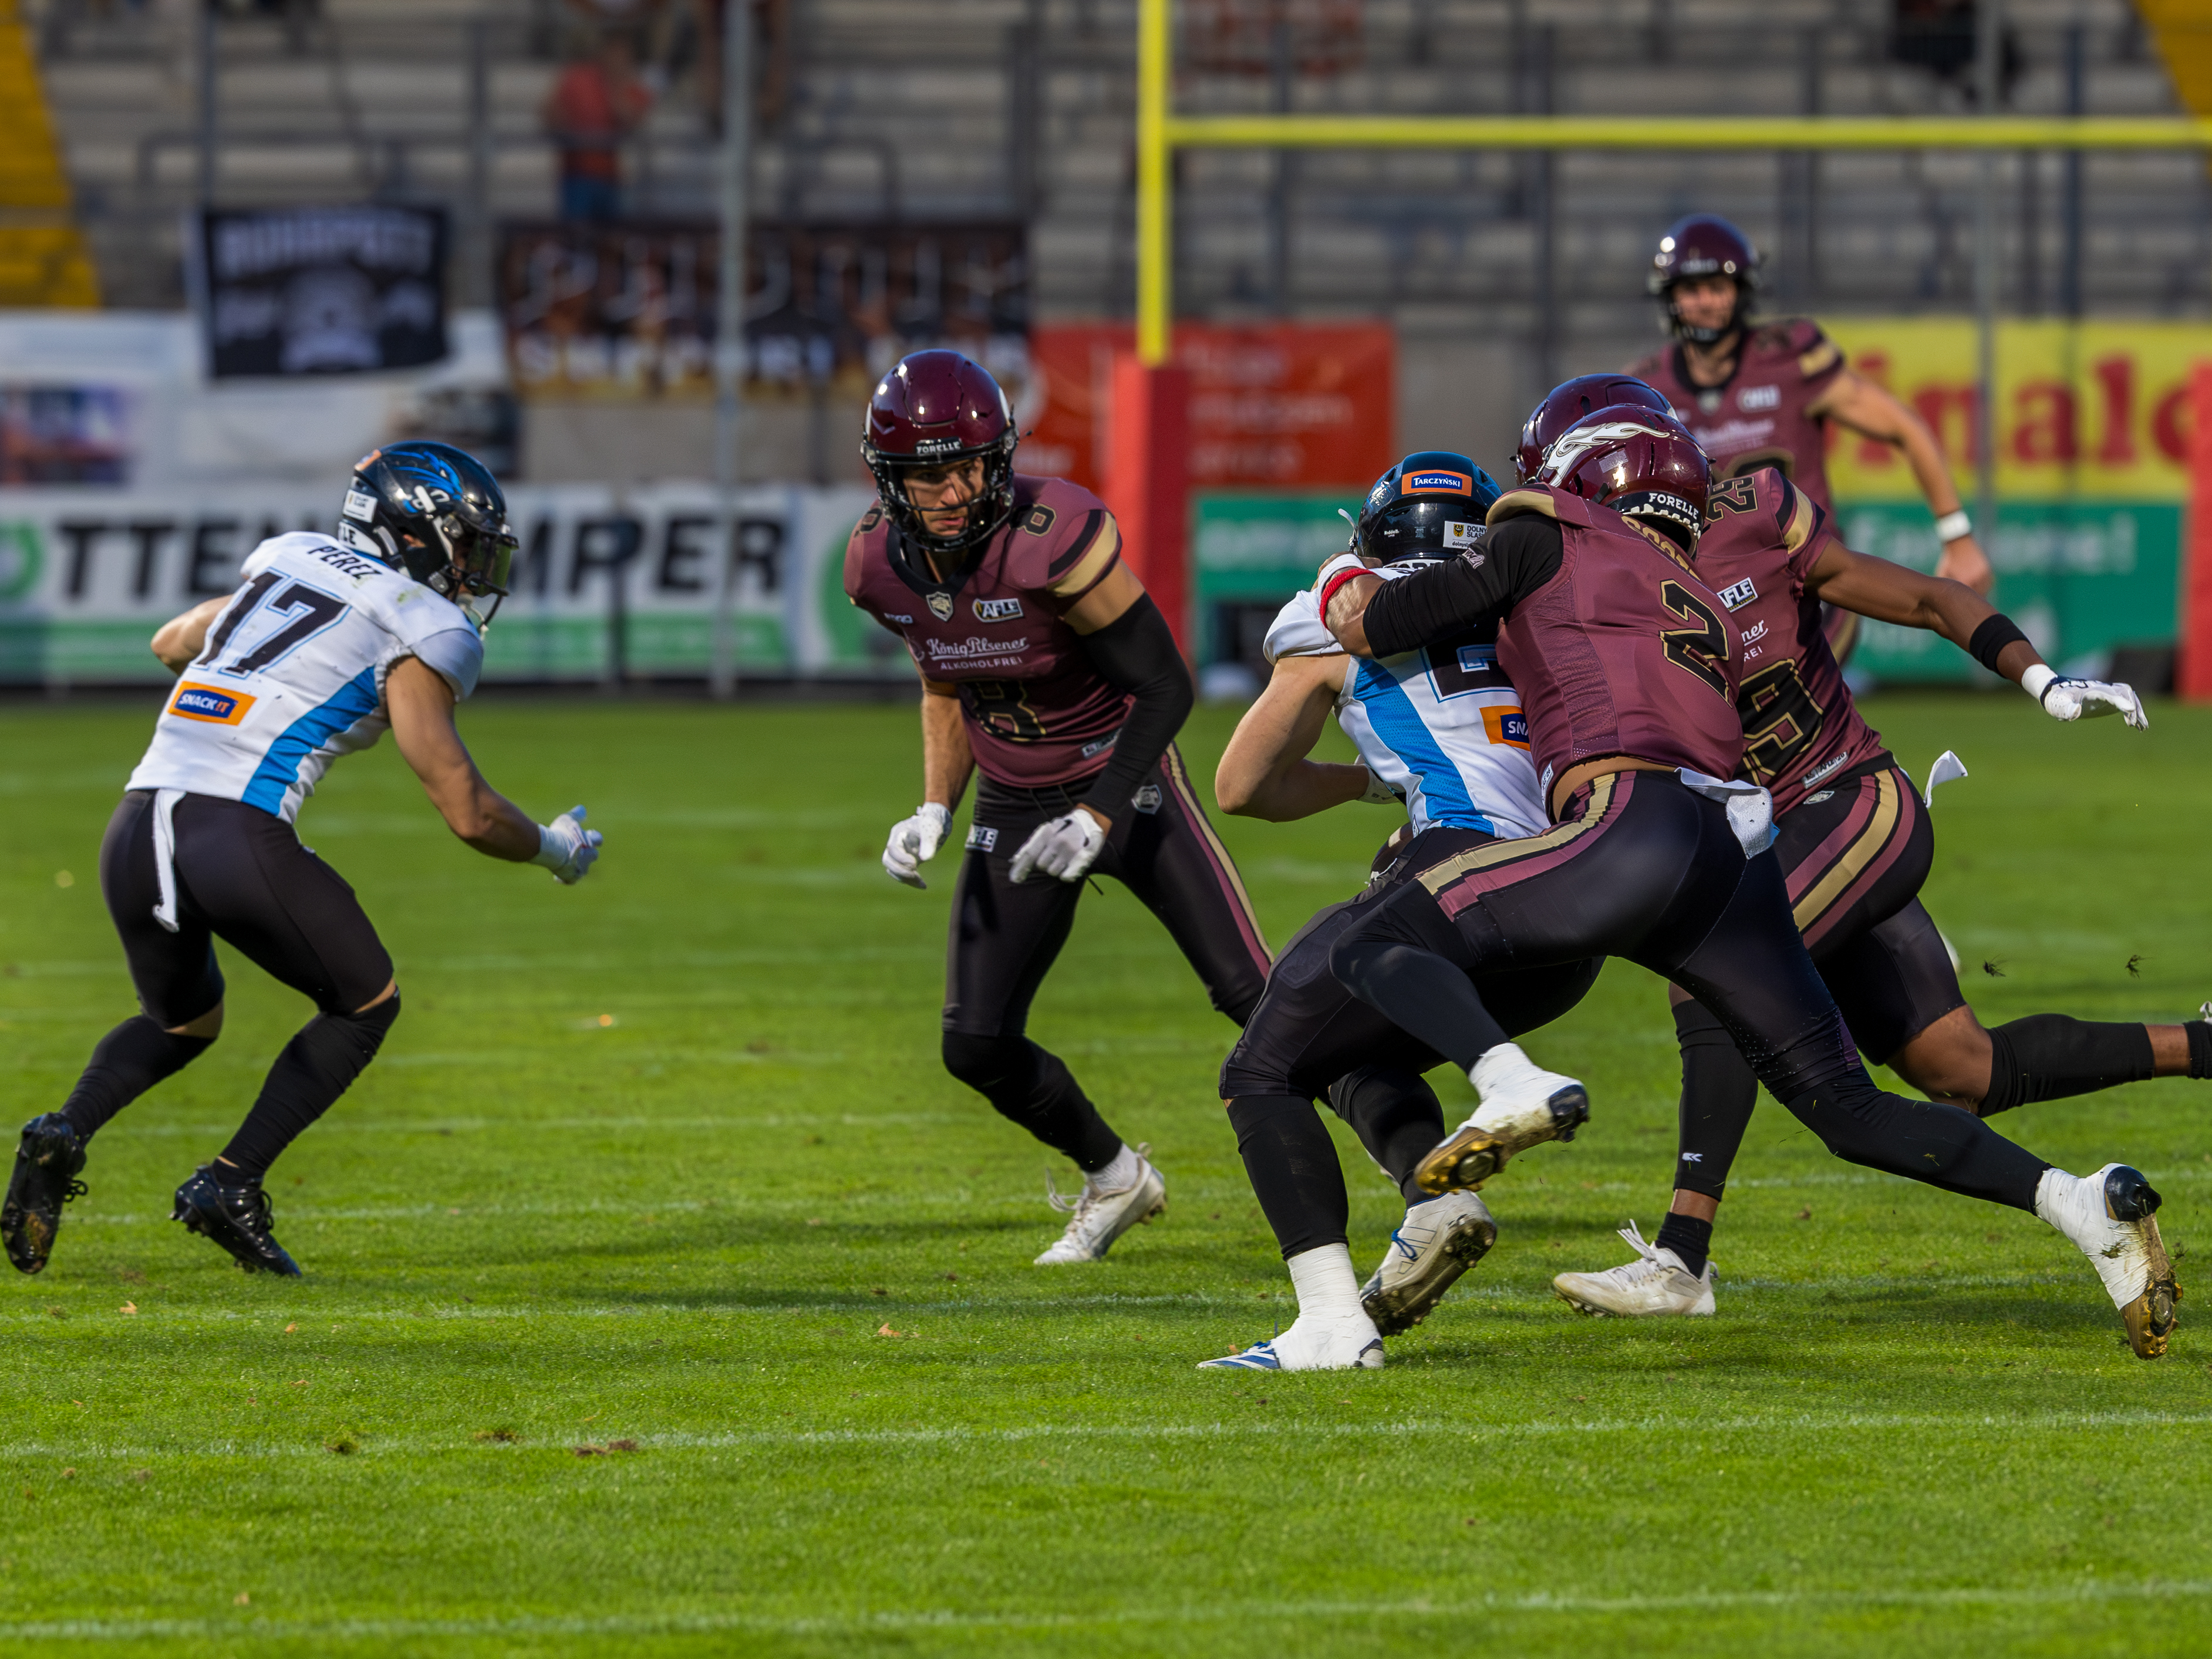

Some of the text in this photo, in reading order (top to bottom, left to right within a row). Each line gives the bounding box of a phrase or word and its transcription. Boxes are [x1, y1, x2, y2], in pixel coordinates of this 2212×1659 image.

[916, 441, 960, 454] FORELLE
[1414, 477, 1461, 487] TARCZYŃSKI
[1648, 492, 1699, 520] FORELLE
[307, 545, 382, 579] PEREZ
[982, 601, 1020, 618] AFLE
[191, 567, 352, 680] 17
[1659, 578, 1732, 709] 2
[940, 656, 1023, 670] ALKOHOLFREI
